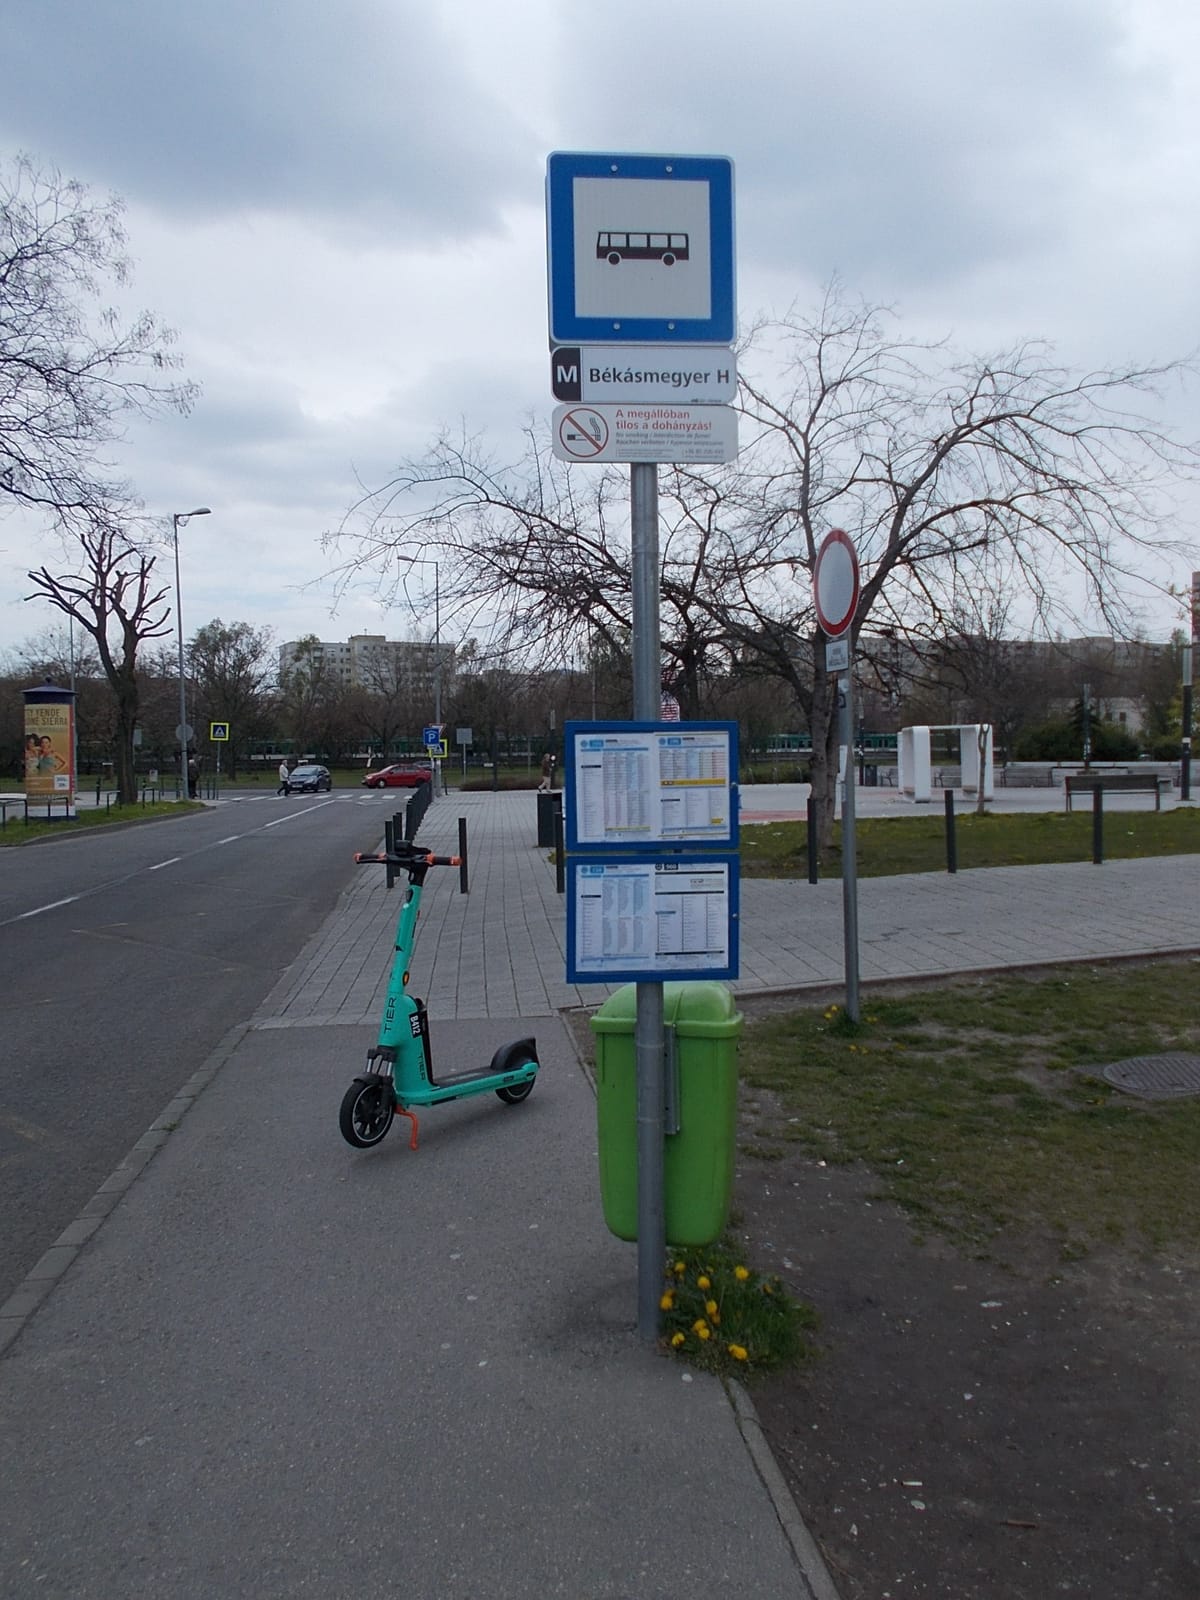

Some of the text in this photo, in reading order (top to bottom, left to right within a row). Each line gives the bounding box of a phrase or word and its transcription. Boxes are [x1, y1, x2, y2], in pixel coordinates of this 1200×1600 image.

[557, 365, 577, 383] M
[589, 367, 729, 388] Békásmegyer H
[615, 409, 690, 420] A megállóban
[616, 421, 639, 430] tilos
[652, 421, 712, 432] dohányzás!
[384, 997, 396, 1034] TIER
[410, 1015, 421, 1034] B412
